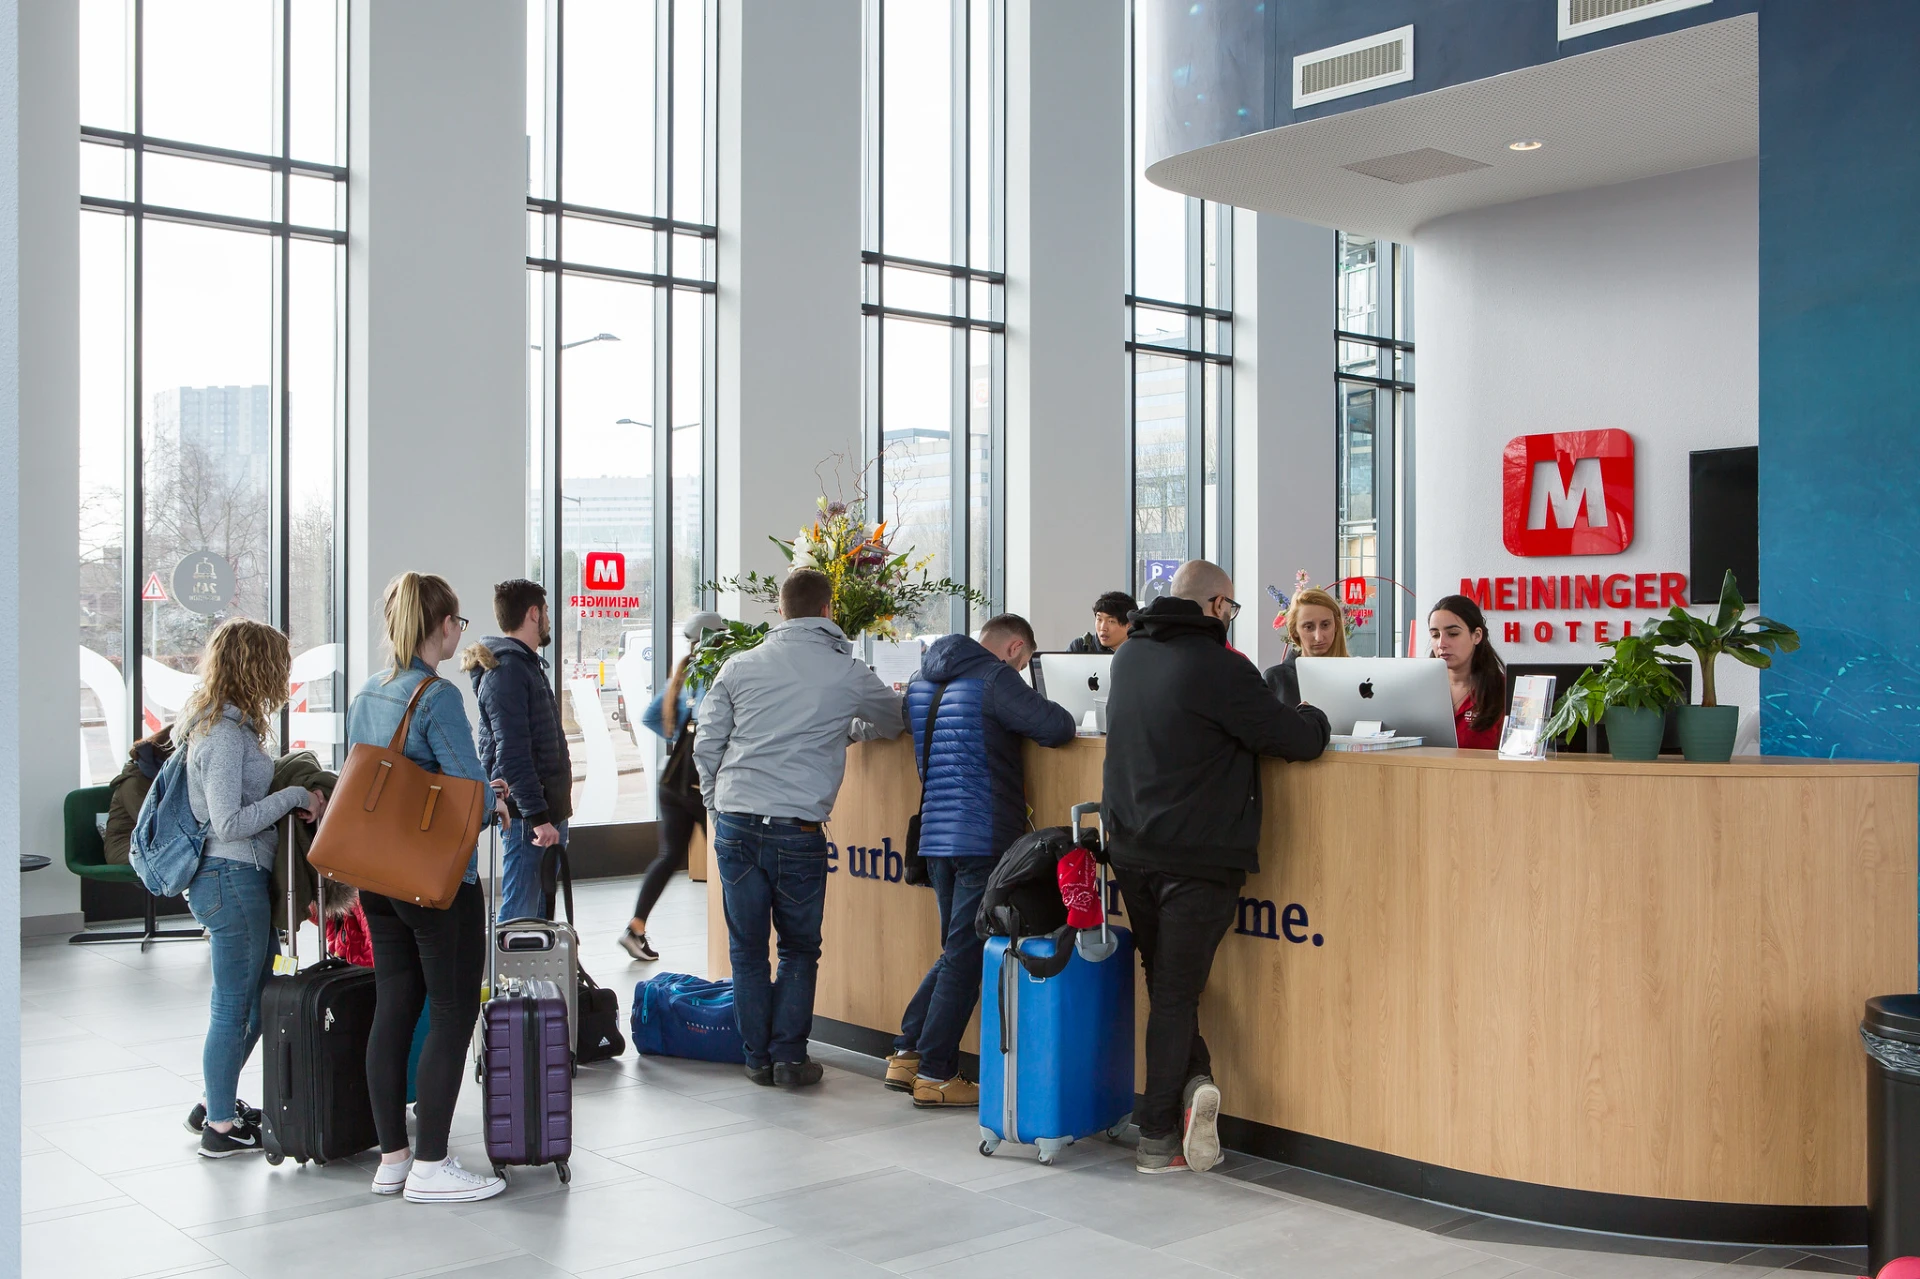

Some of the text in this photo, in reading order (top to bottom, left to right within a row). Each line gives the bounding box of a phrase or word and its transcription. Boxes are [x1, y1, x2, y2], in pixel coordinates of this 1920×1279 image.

[1526, 457, 1608, 530] M
[1459, 572, 1689, 611] MEININGER
[1503, 620, 1632, 643] HOTEL
[846, 836, 904, 883] urb
[1234, 894, 1325, 947] me.
